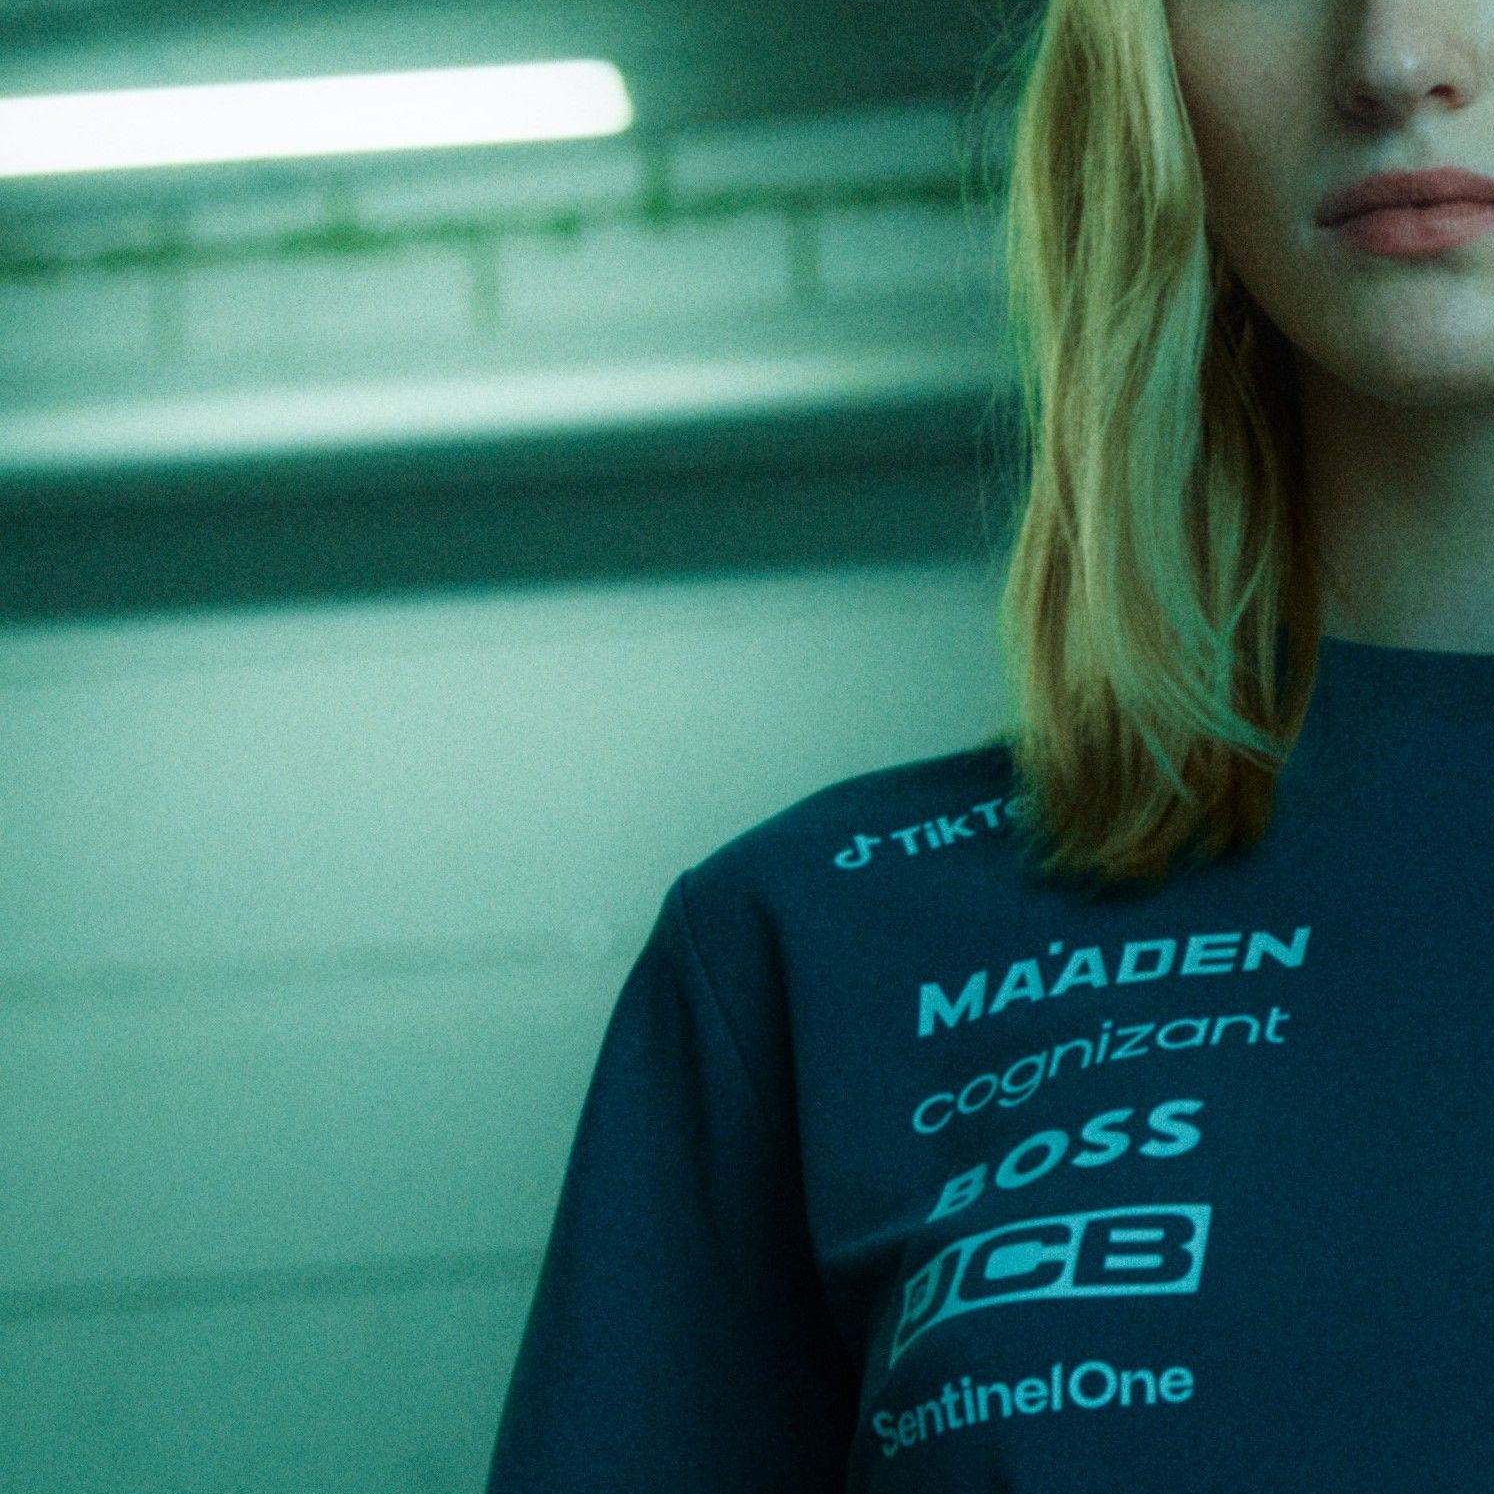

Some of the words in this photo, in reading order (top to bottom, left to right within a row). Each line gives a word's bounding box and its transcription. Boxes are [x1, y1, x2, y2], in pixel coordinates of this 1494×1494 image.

[912, 1007, 1290, 1135] cognizant
[926, 1099, 1204, 1223] BOSS
[896, 1211, 1200, 1355] JCB
[872, 1360, 1195, 1458] SentinelOne
